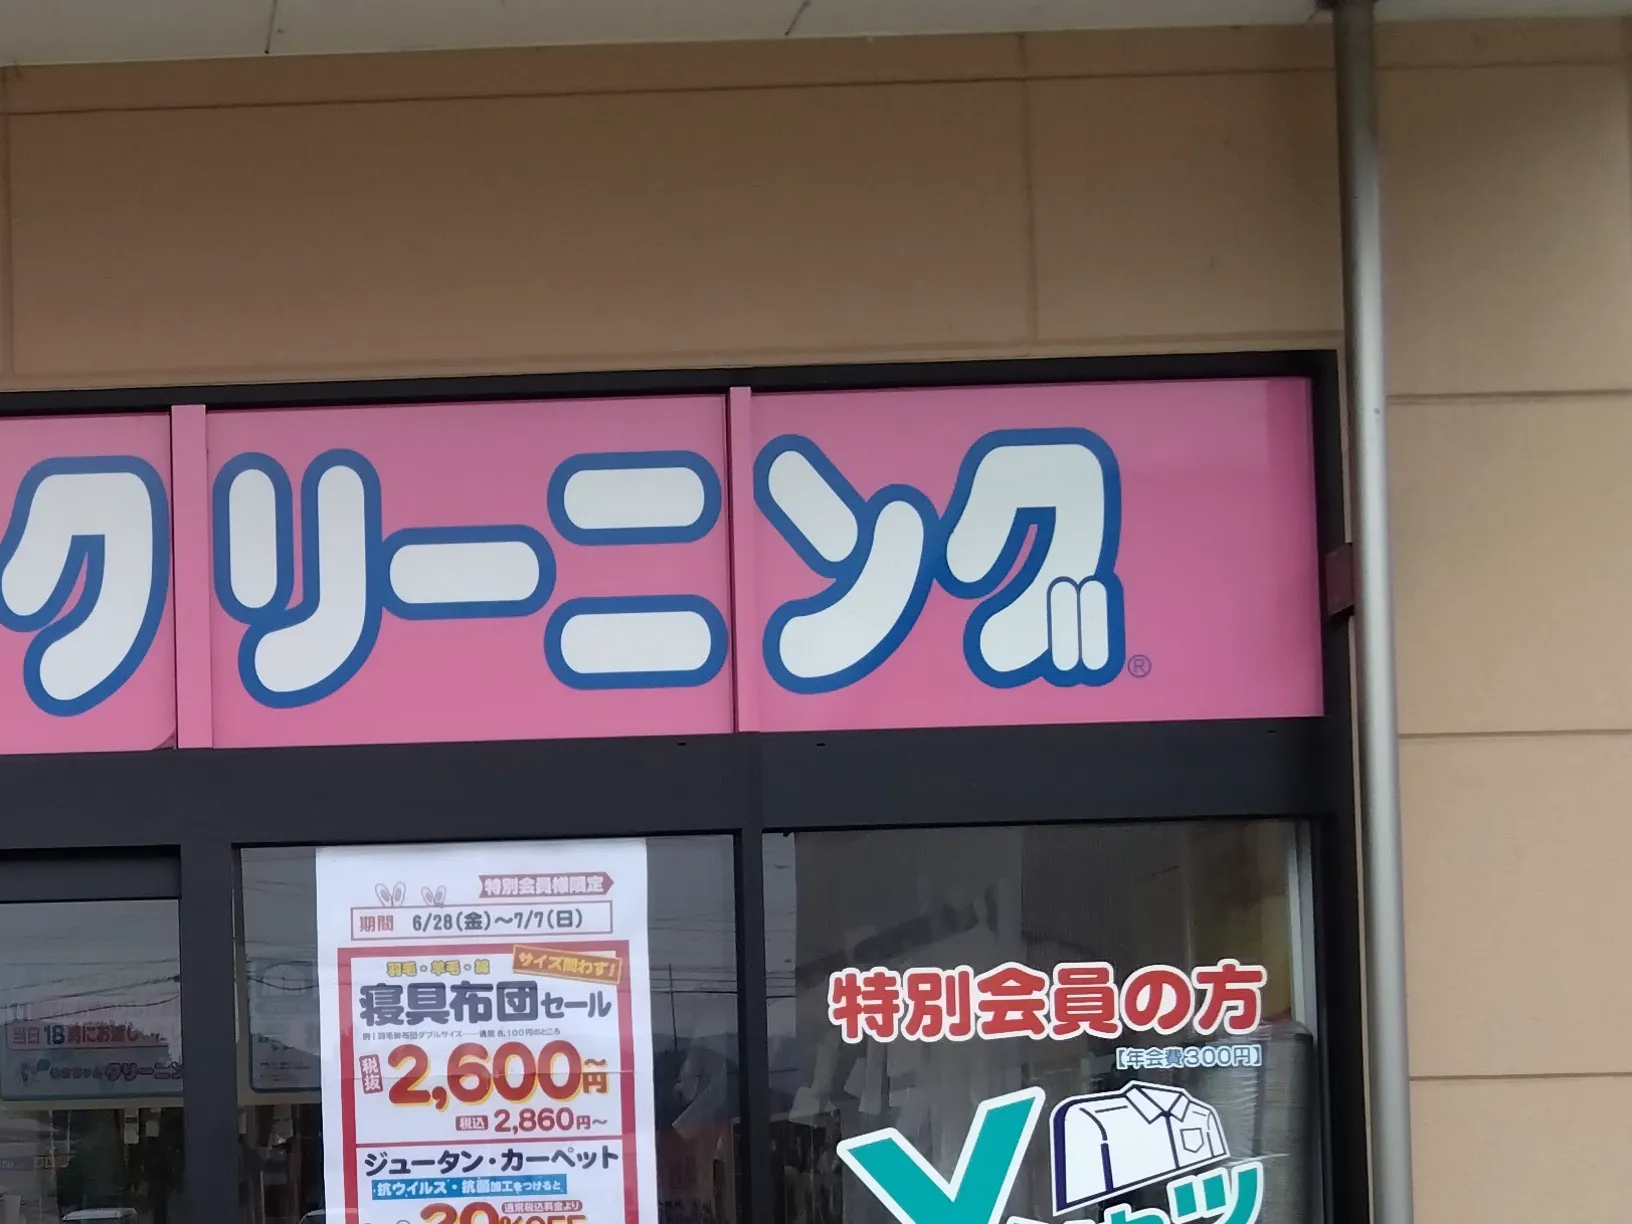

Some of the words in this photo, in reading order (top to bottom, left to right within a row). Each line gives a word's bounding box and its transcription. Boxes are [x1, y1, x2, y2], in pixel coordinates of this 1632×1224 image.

[485, 876, 603, 895] 特別会員様限定
[359, 915, 394, 932] 期間
[358, 980, 612, 1027] 寝具布団セール
[828, 958, 1267, 1044] 特別会員の方
[361, 1058, 382, 1091] 税抜
[459, 1116, 486, 1130] 税込
[364, 1146, 619, 1176] ジュータン・カーペット
